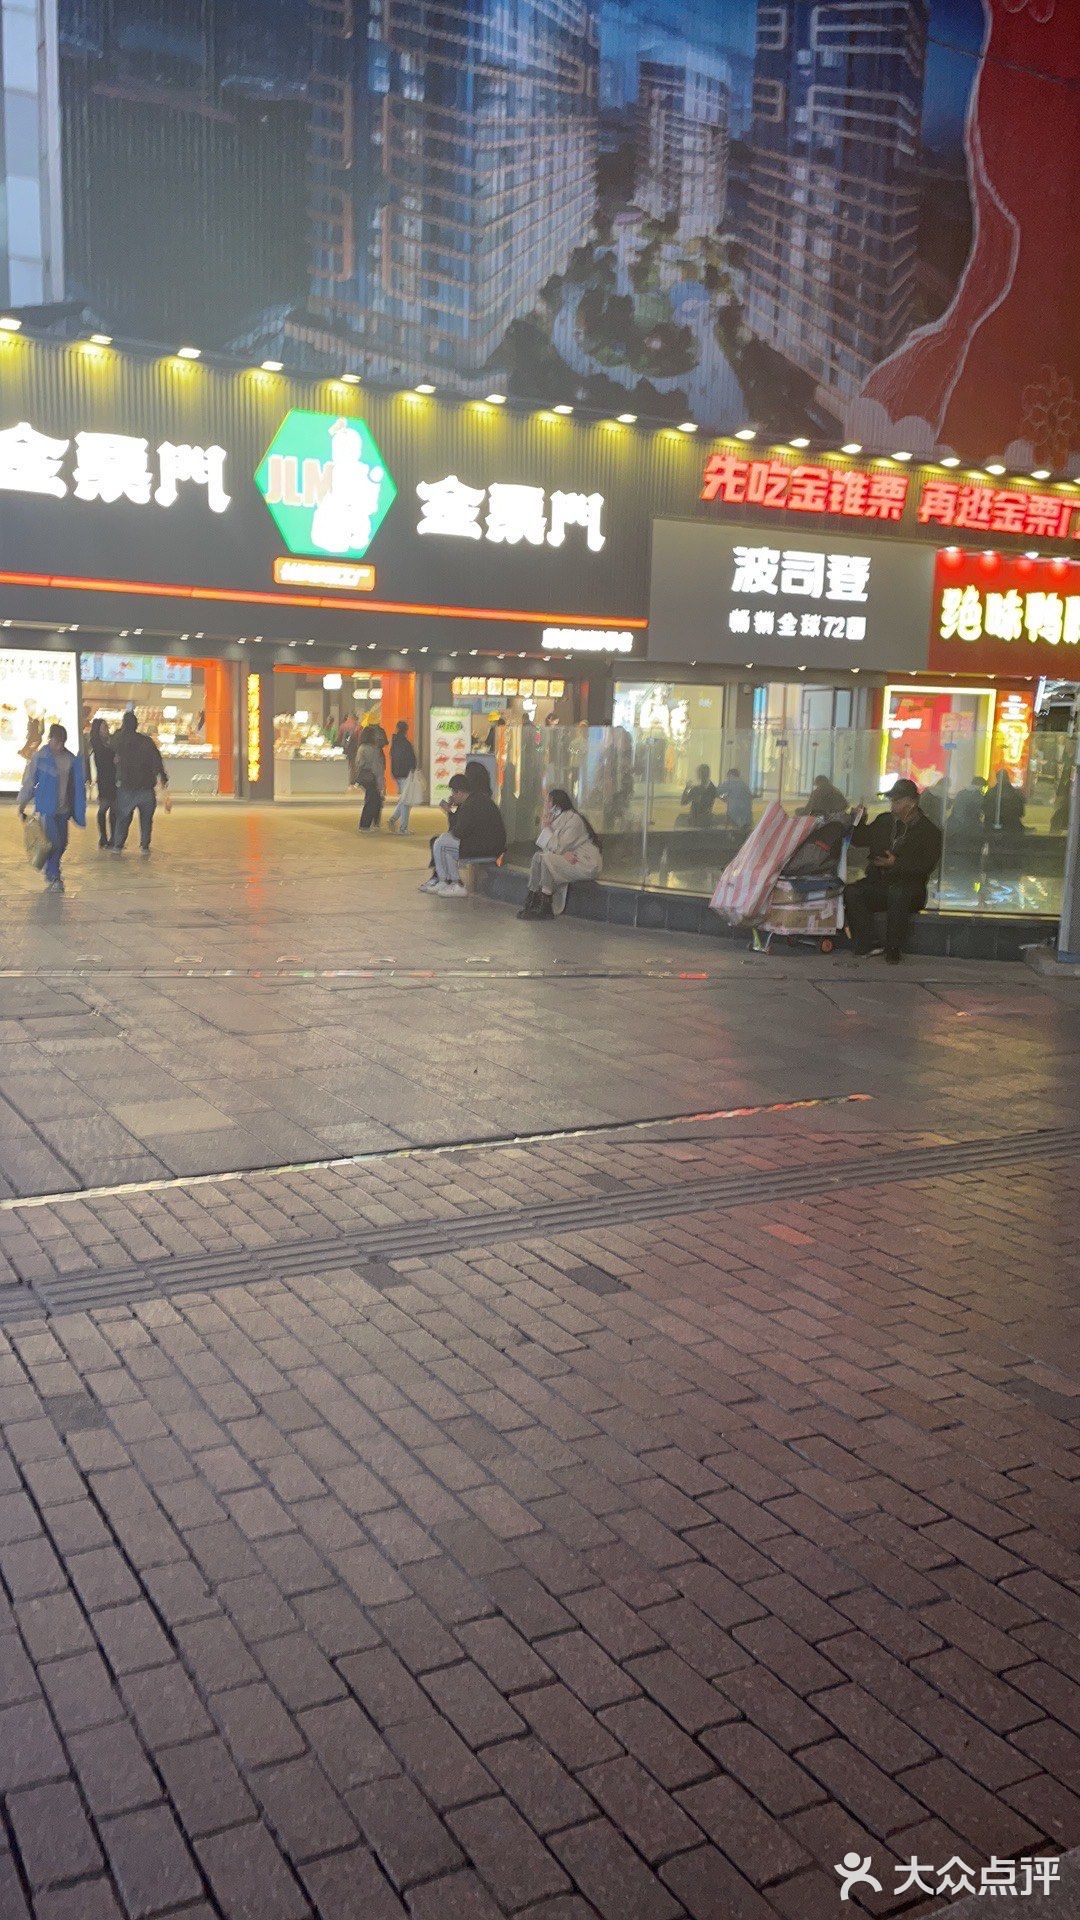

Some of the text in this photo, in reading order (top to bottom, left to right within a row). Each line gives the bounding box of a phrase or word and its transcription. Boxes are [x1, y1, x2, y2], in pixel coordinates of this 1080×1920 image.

[266, 454, 335, 507] JLM
[731, 546, 872, 602] 波司登
